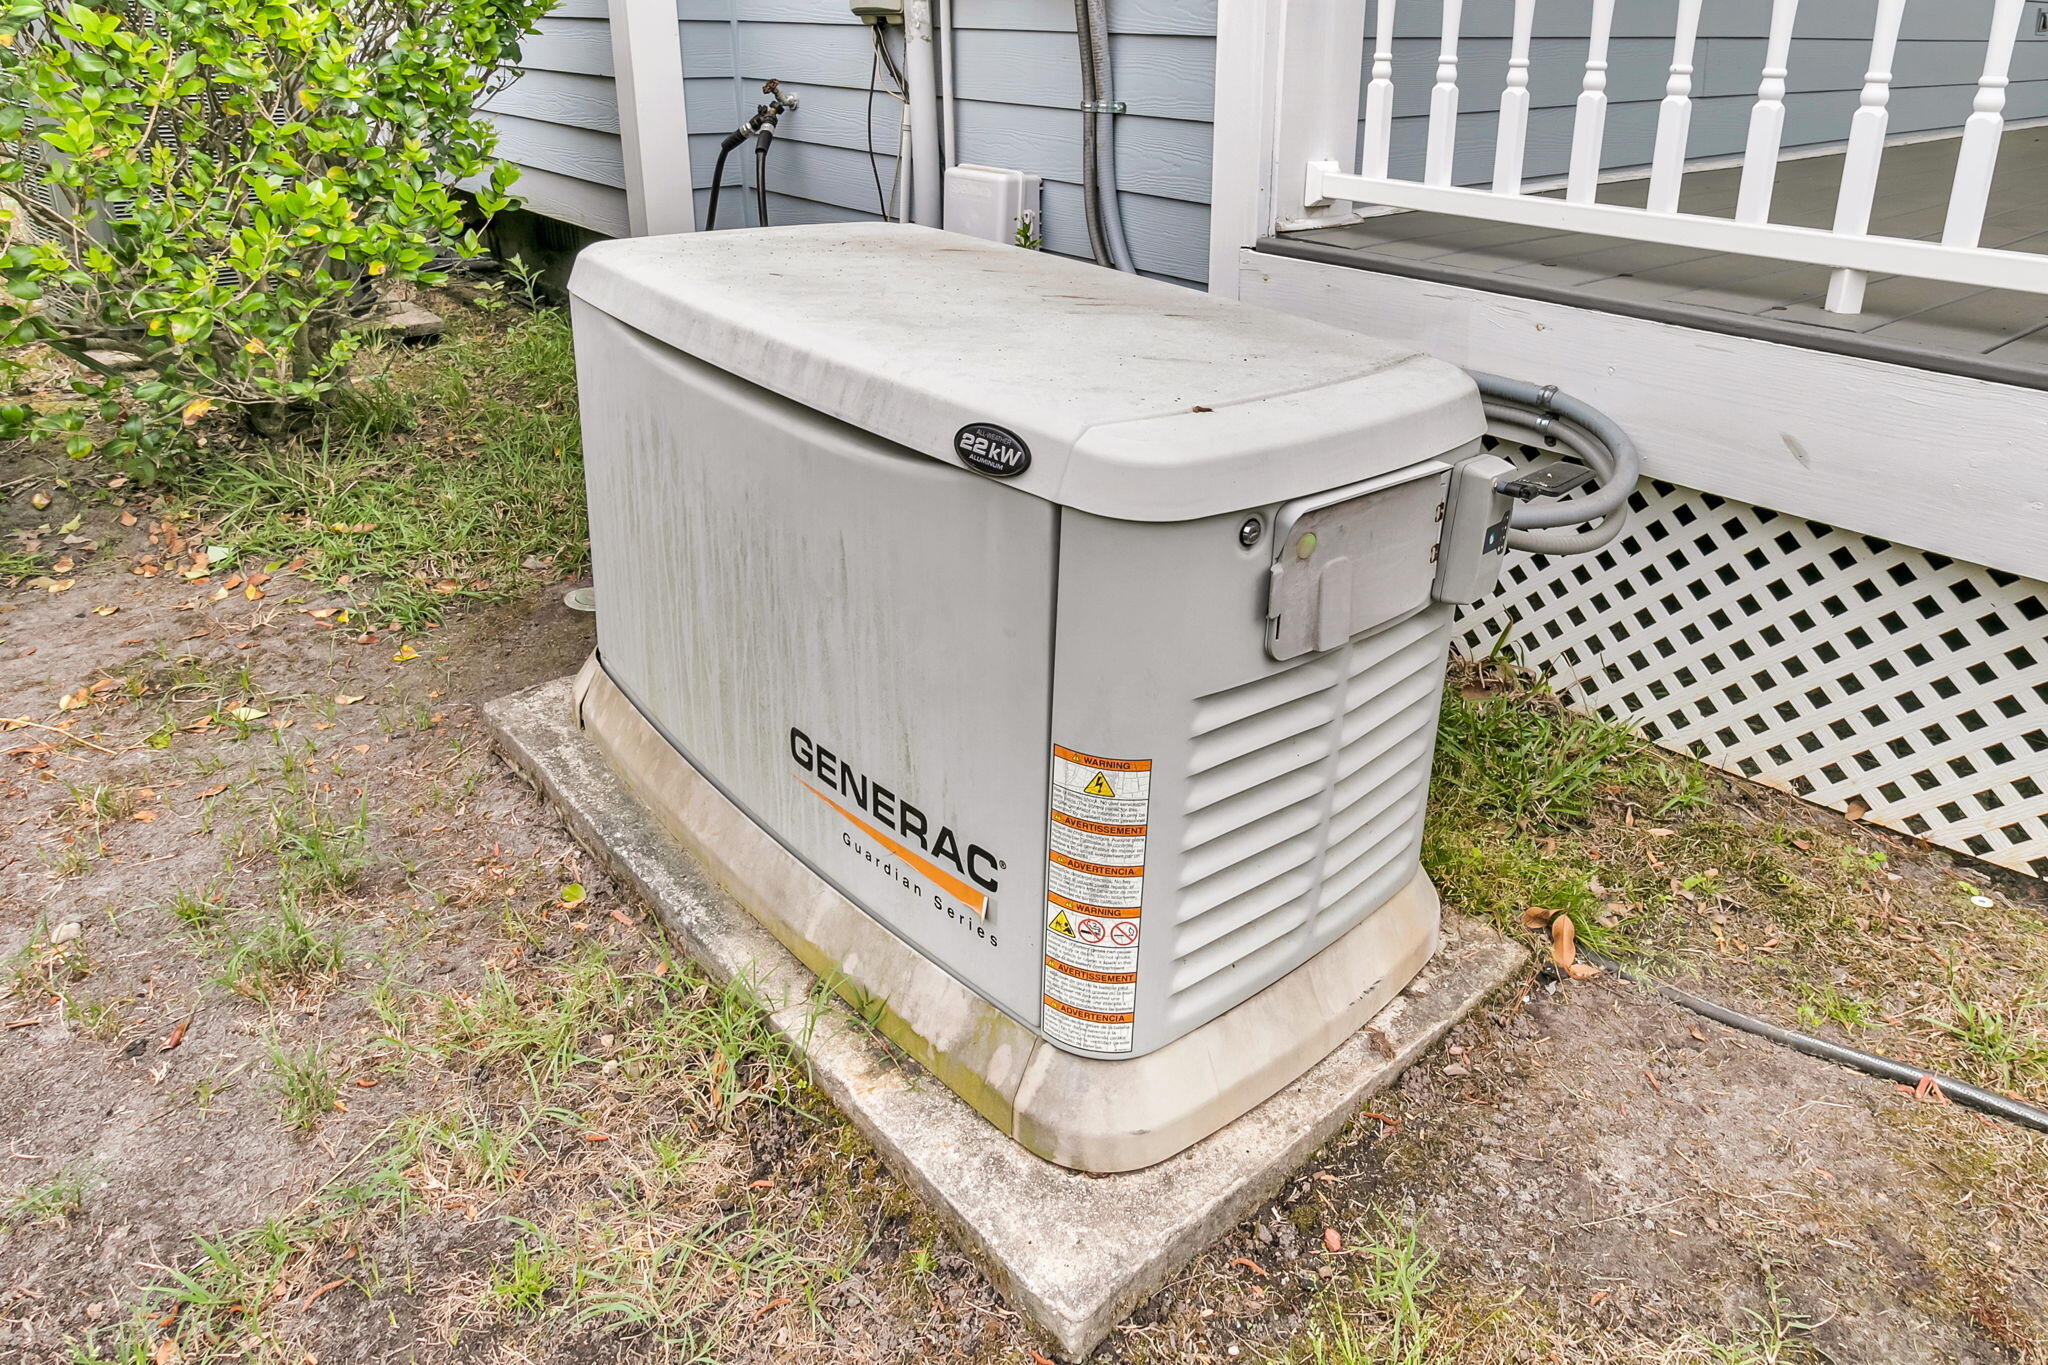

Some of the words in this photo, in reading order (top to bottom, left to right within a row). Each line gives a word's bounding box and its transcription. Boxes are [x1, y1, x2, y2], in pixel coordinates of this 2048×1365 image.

[968, 454, 1004, 471] ALUMINUM
[1083, 756, 1131, 770] WARNING
[790, 726, 999, 893] GENERAC
[1064, 817, 1144, 835] AVERTISSEMENT
[1067, 859, 1135, 876] ADVERTENCIA
[842, 831, 922, 897] Guardian
[933, 895, 999, 947] Series
[1076, 904, 1122, 917] WARNING
[1057, 964, 1134, 982] AVERTISSEMENT
[1060, 1005, 1126, 1022] ADVERTENCIA
